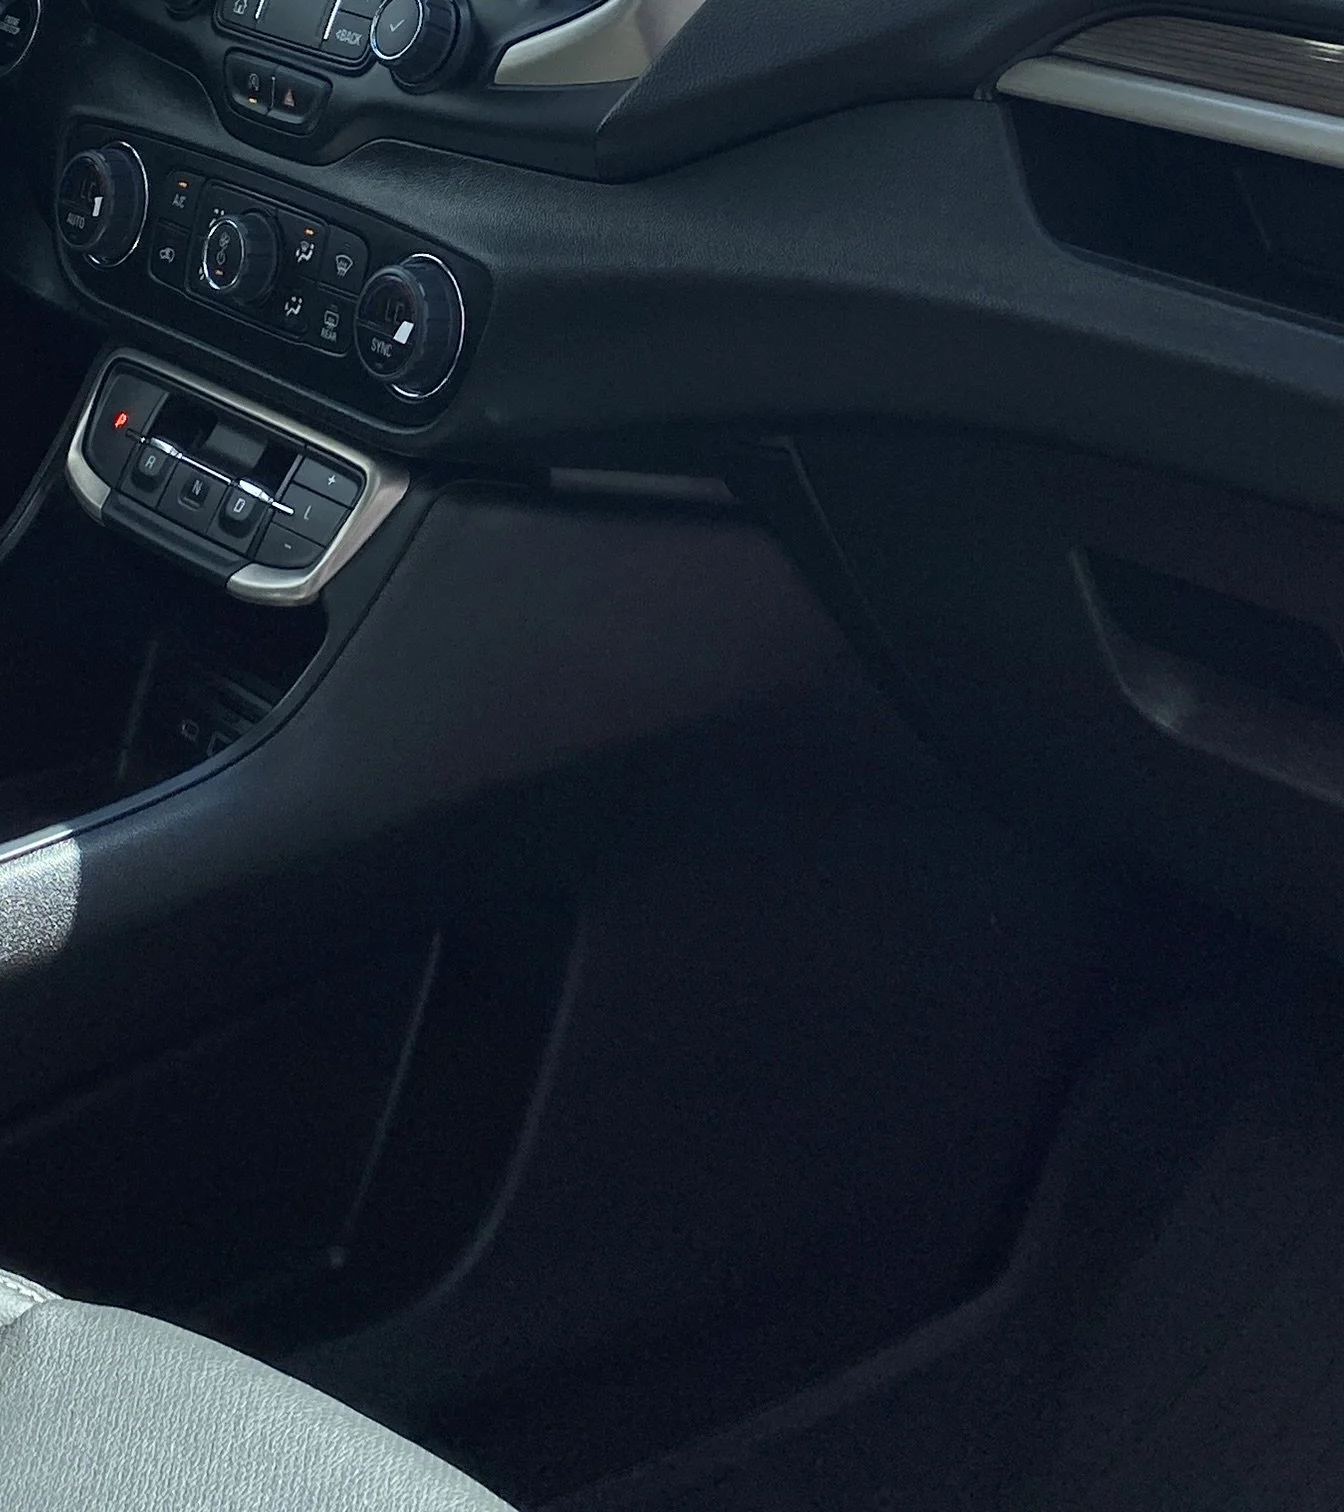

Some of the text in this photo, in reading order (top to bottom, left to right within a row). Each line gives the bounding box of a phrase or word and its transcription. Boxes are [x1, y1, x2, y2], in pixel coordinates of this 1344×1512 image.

[341, 30, 363, 47] BACK
[66, 212, 86, 229] AUTO
[370, 337, 393, 358] SYNC
[114, 412, 128, 429] P
[144, 454, 156, 469] R
[191, 479, 203, 496] N
[233, 497, 246, 513] D
[303, 504, 312, 521] L
